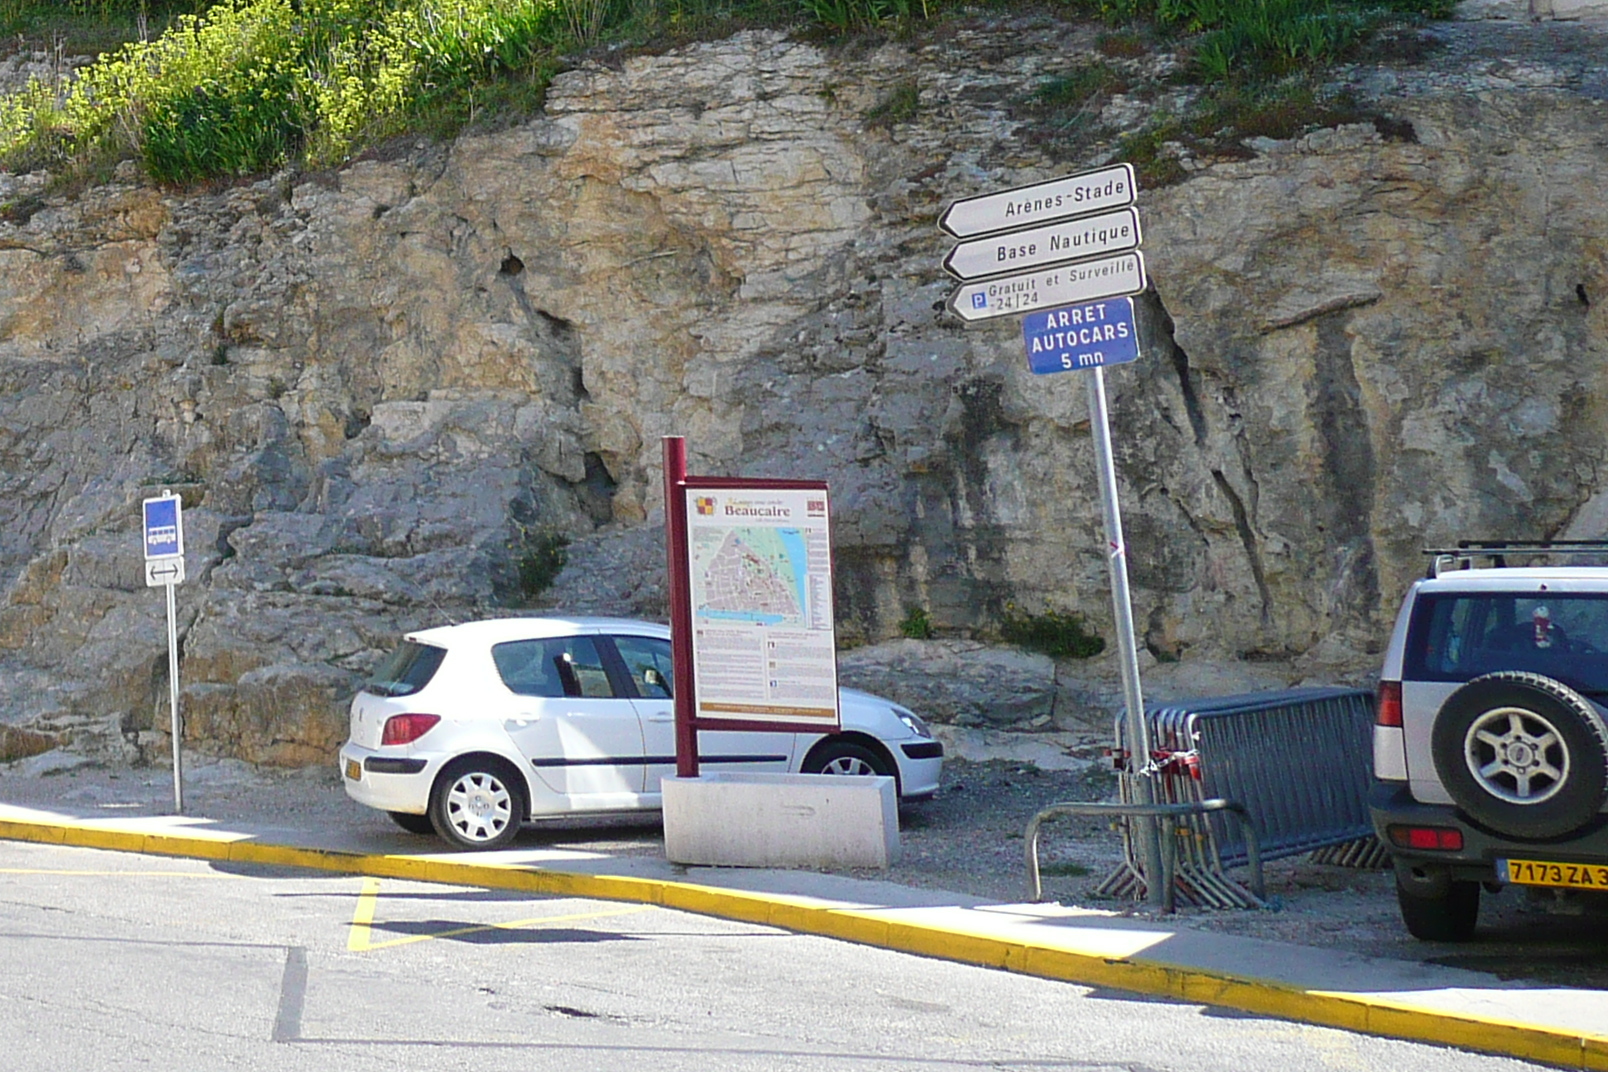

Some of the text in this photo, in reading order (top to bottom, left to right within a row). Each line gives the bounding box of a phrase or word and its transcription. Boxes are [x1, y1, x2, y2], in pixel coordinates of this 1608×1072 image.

[1005, 180, 1124, 217] Arènes-Stade
[997, 225, 1129, 262] Base Nautique
[989, 279, 1036, 297] Gratuit
[1046, 275, 1060, 286] et
[1069, 259, 1134, 282] Surveillé
[1047, 304, 1106, 330] ARRET
[1032, 322, 1129, 353] AUTOCARS
[1061, 352, 1104, 369] 5 mn
[725, 505, 791, 517] Beaucaire
[1510, 862, 1562, 882] 7173
[1566, 867, 1593, 884] ZA
